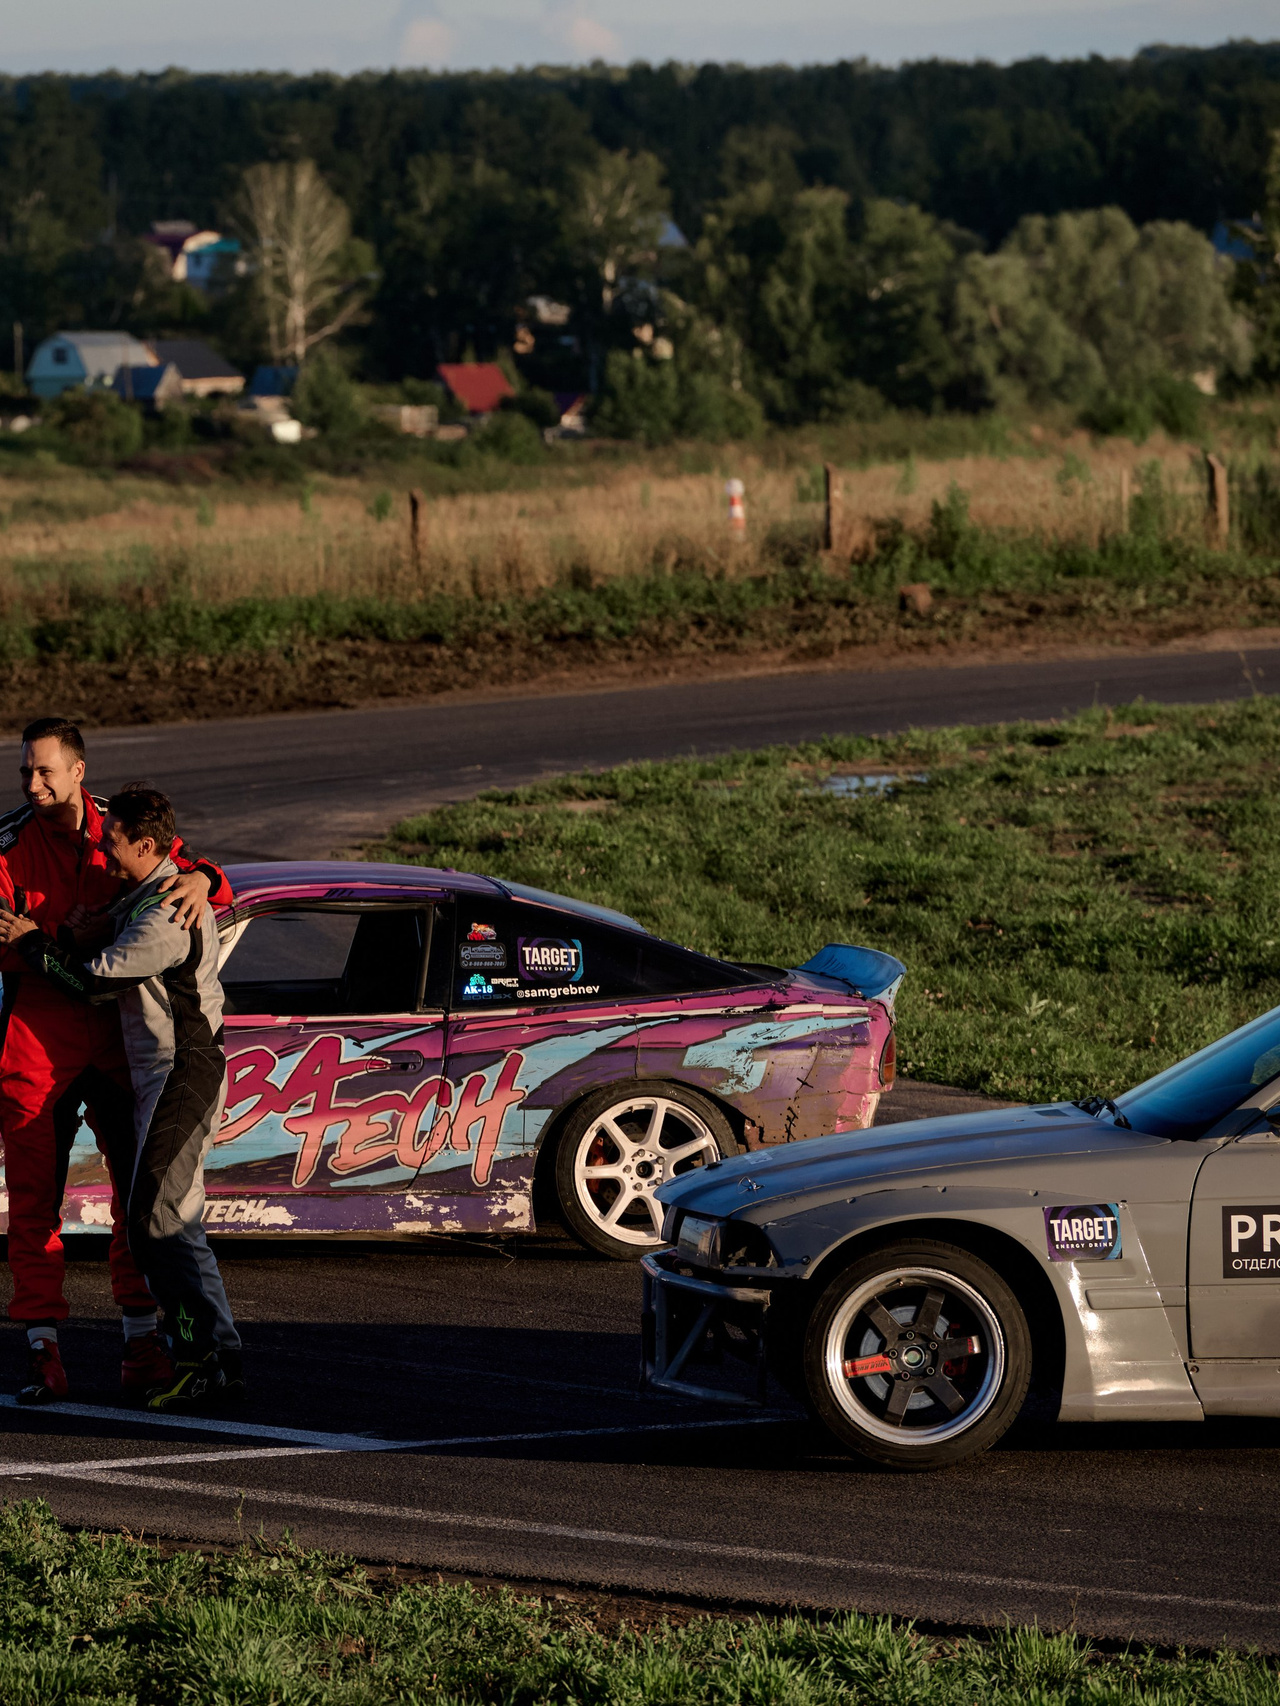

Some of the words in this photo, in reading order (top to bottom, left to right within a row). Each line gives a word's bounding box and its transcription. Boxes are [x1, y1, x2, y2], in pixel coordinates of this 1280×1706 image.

[522, 946, 578, 966] TARGET
[463, 984, 493, 995] AK-18
[516, 984, 600, 999] @samgrebnev
[283, 1049, 528, 1188] TECH
[1049, 1216, 1116, 1241] TARGET
[1230, 1213, 1280, 1253] PR
